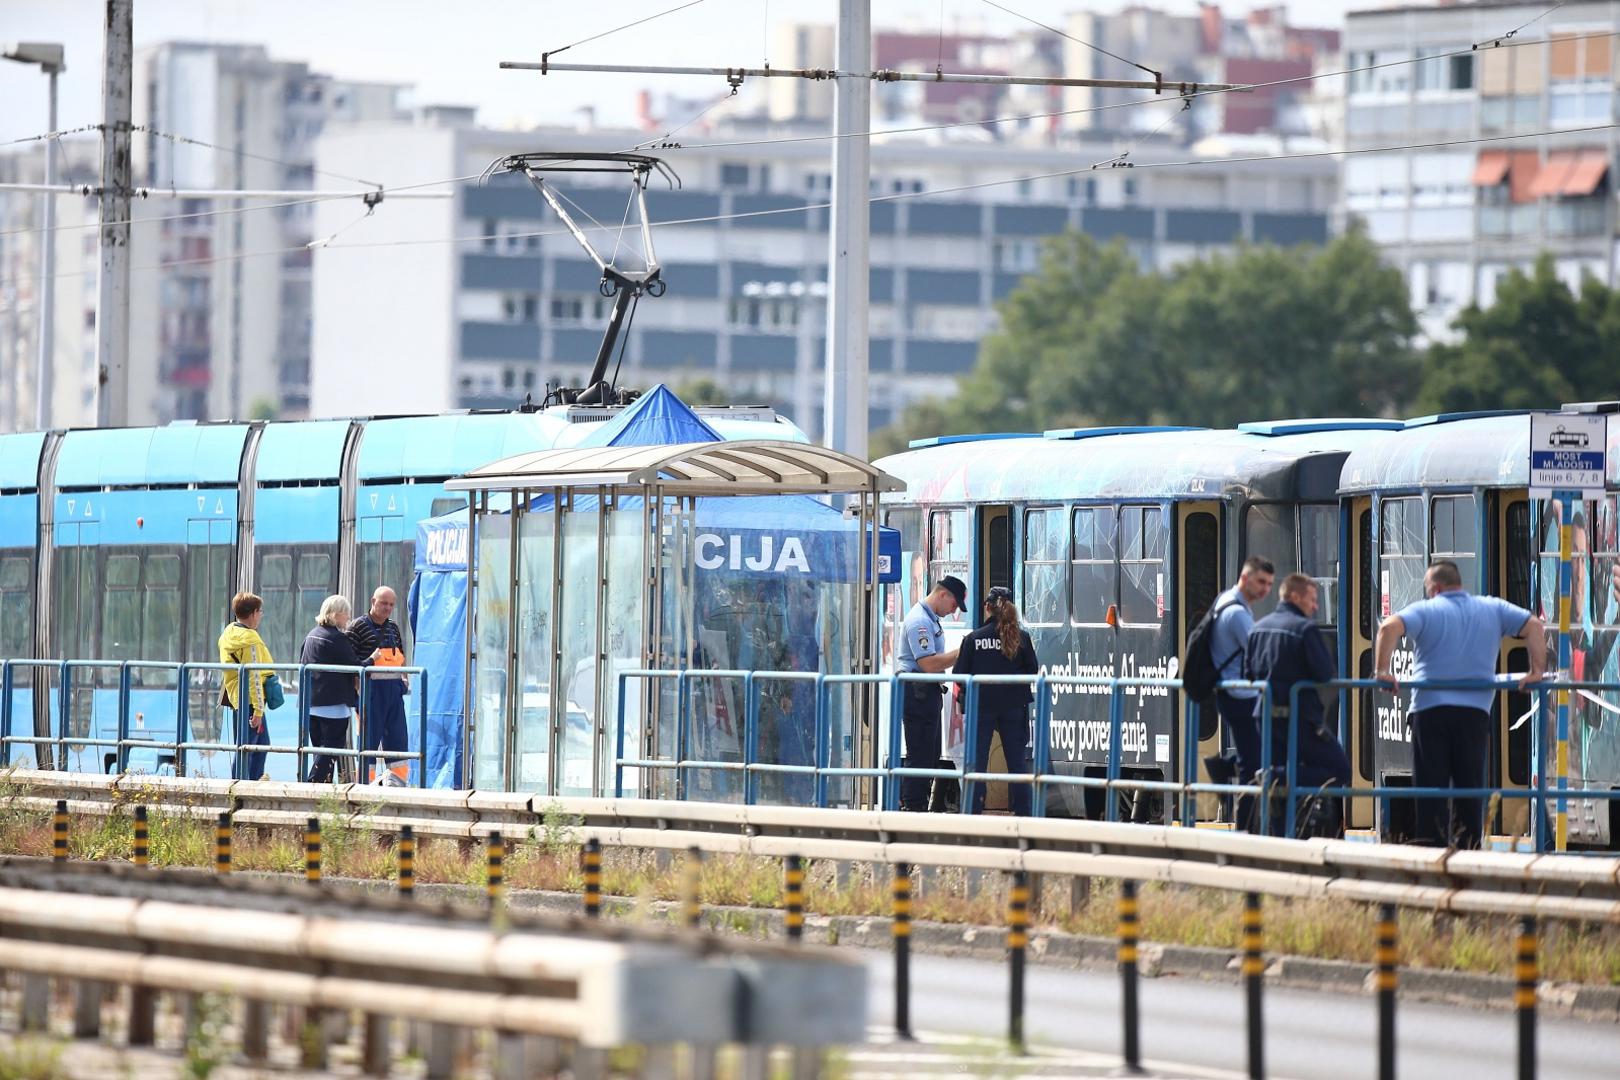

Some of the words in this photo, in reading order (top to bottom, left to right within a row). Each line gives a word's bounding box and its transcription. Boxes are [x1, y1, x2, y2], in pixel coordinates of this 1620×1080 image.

[1543, 460, 1593, 469] MLADOSTI
[1554, 452, 1582, 461] MOST
[1539, 471, 1563, 484] linije
[1592, 473, 1599, 482] 8
[427, 528, 468, 565] POLICIJA
[653, 533, 811, 573] CIJA
[975, 637, 1002, 650] POLIC
[1389, 636, 1415, 682] eža
[1049, 711, 1076, 761] tvog
[1377, 695, 1403, 742] radi
